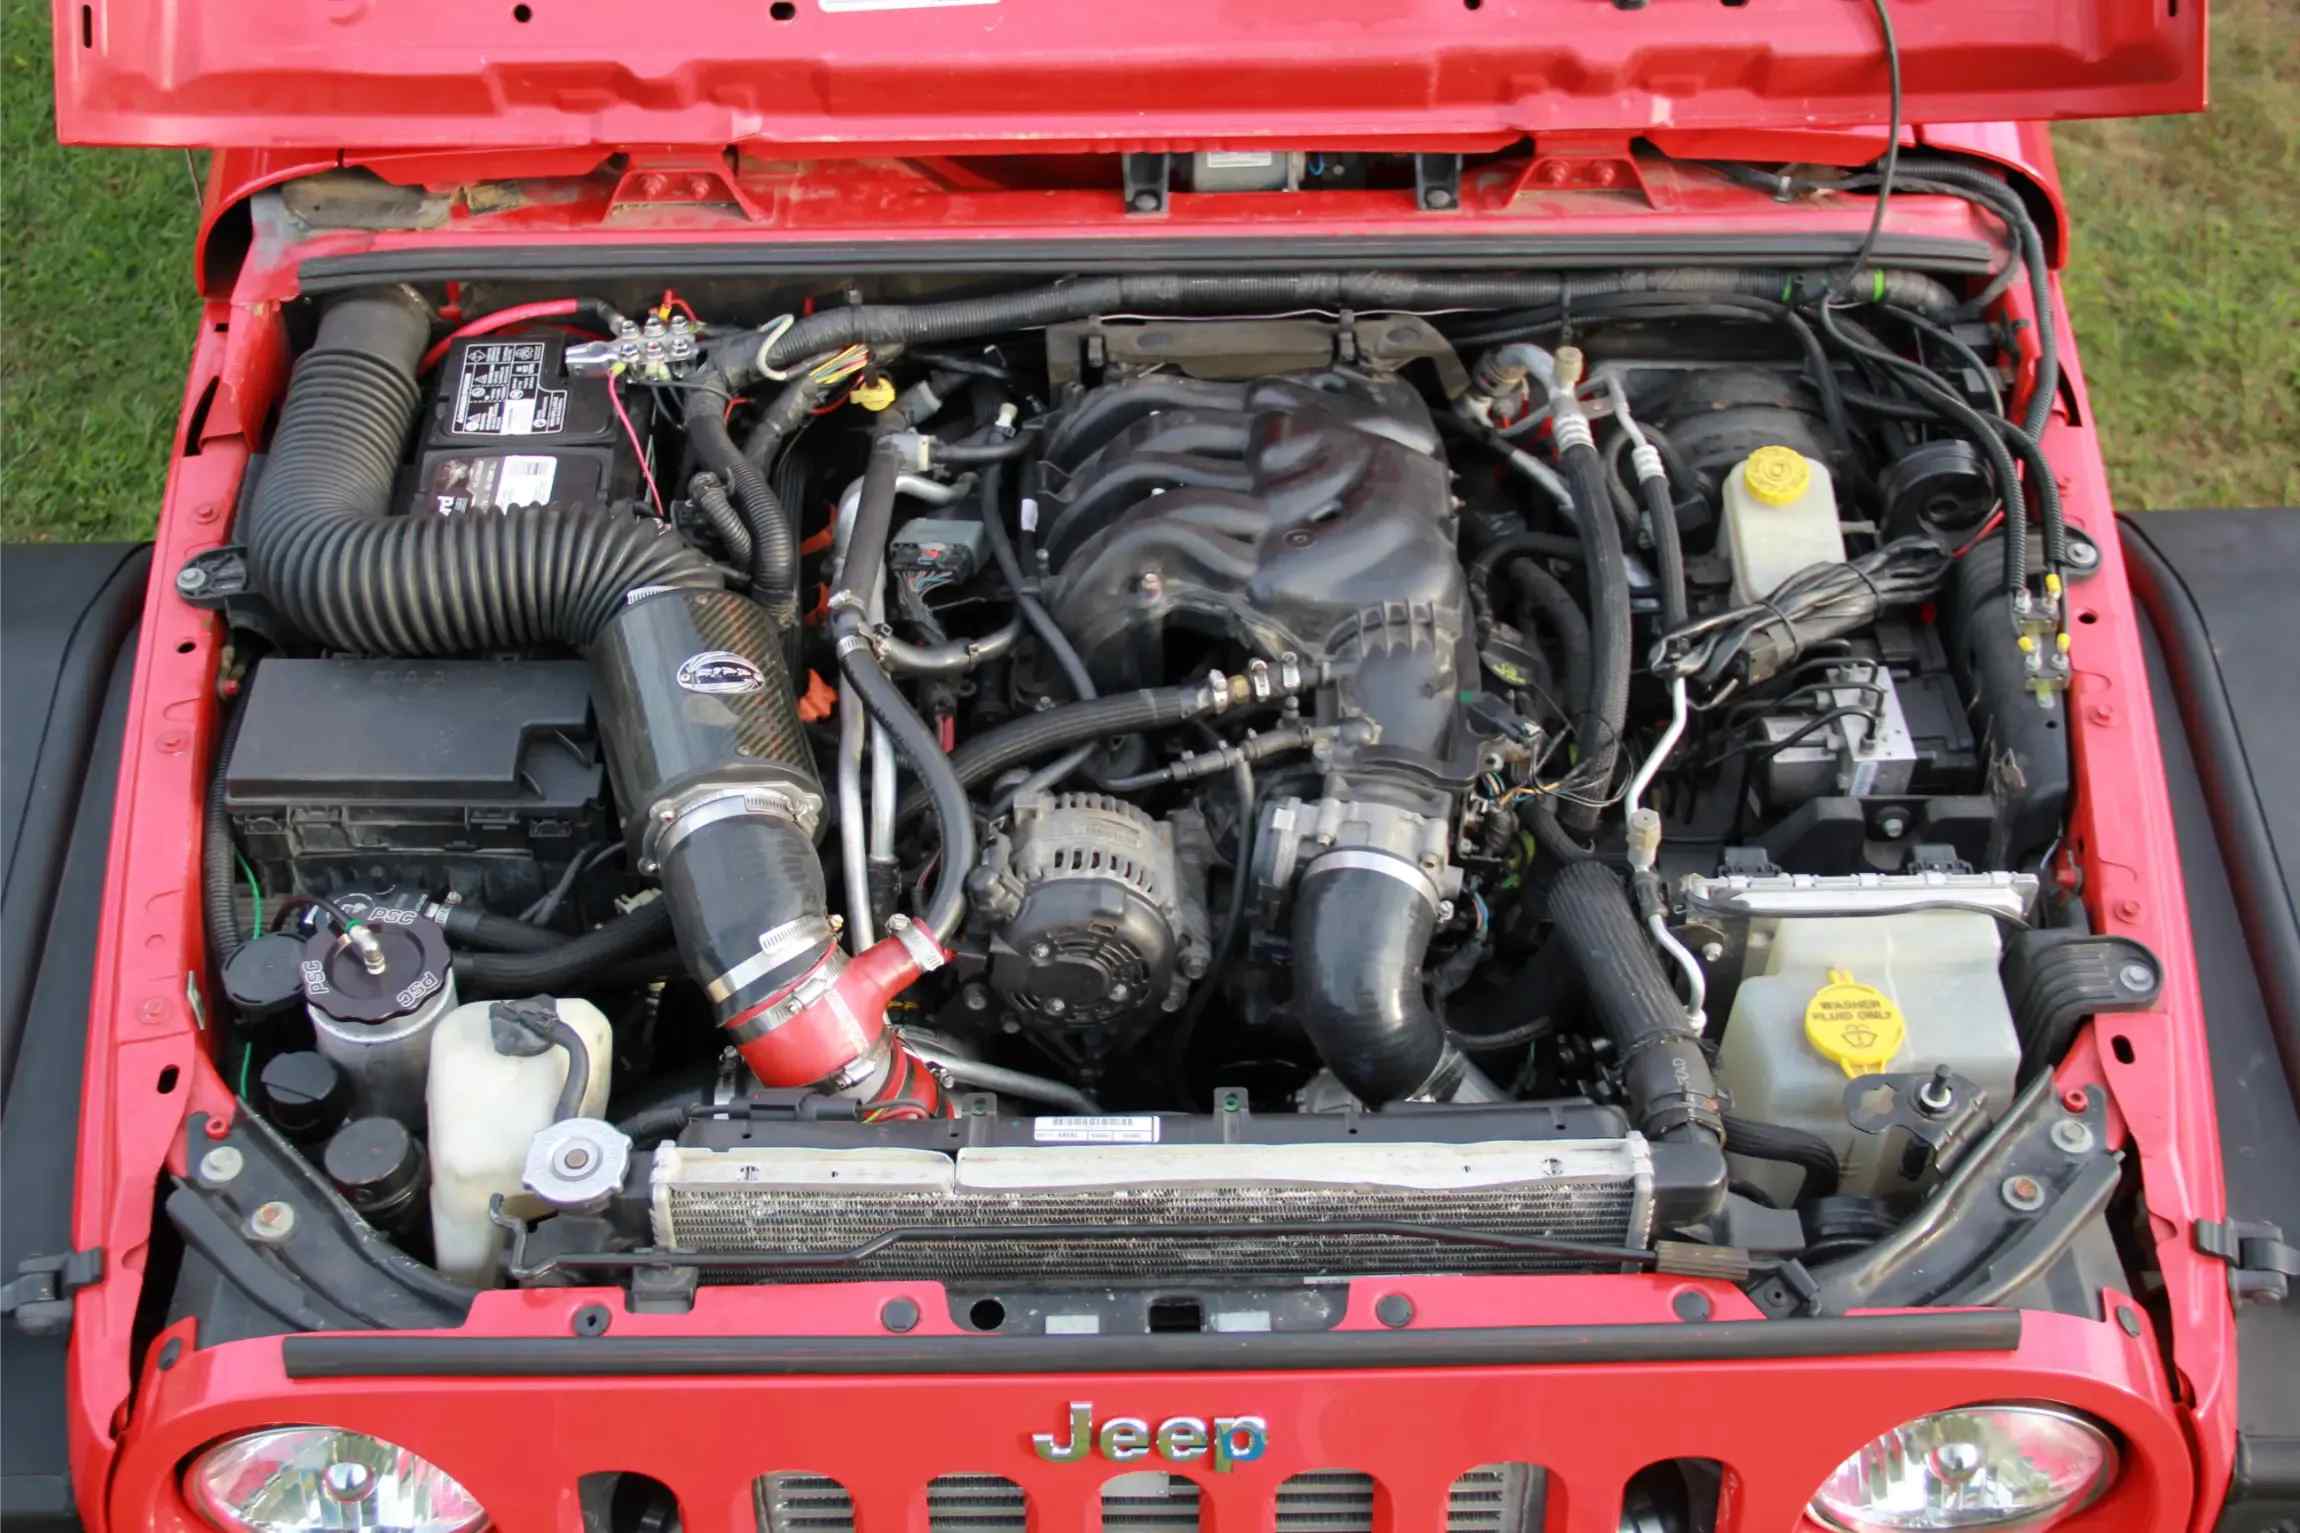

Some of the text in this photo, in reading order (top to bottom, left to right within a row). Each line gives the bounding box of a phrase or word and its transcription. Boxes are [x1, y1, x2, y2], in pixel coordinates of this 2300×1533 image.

[368, 907, 417, 925] PSC
[302, 960, 330, 995] PSC
[396, 970, 440, 1007] PSC
[1819, 999, 1881, 1010] WASHER
[1857, 1010, 1892, 1020] ONLY
[1032, 1401, 1268, 1473] Jeep
